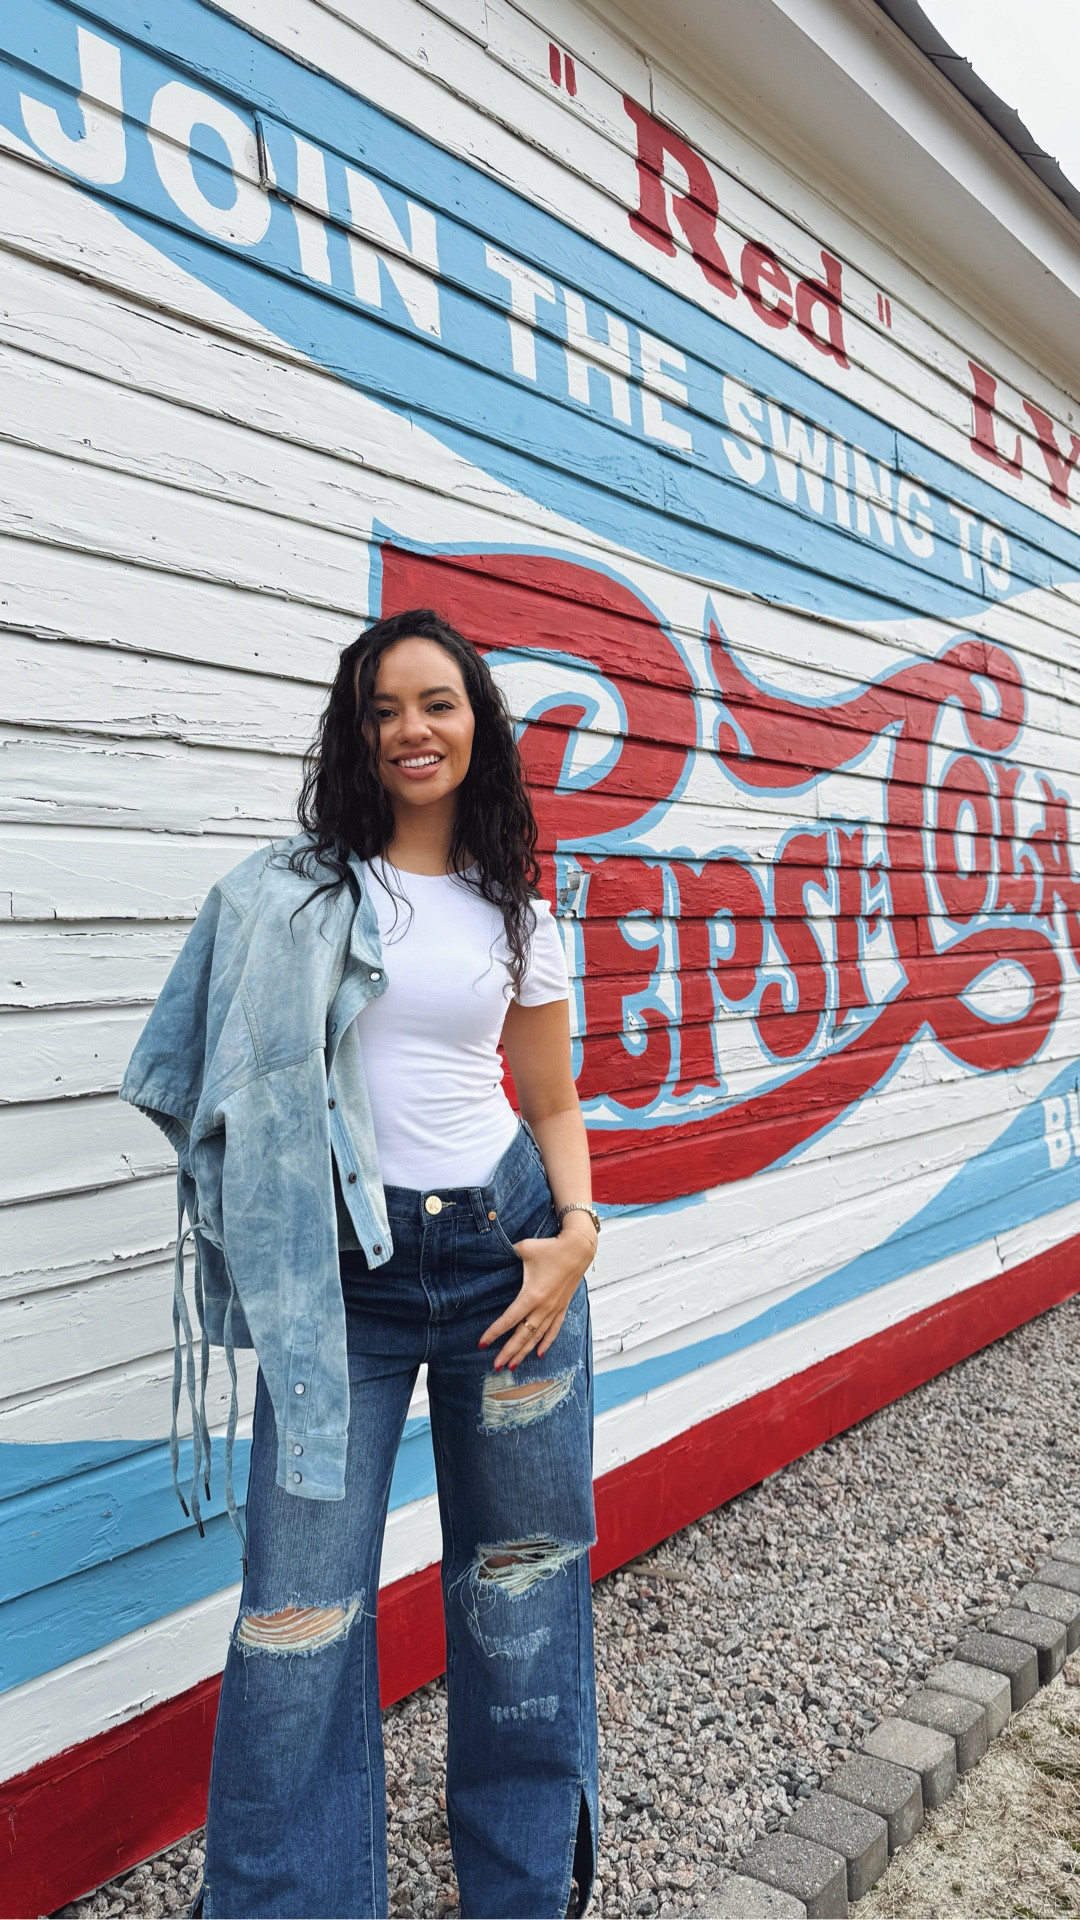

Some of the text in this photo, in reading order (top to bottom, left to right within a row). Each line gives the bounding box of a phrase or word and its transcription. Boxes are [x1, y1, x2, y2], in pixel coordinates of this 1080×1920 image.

[19, 25, 1012, 591] JOIN THE SWING TO
